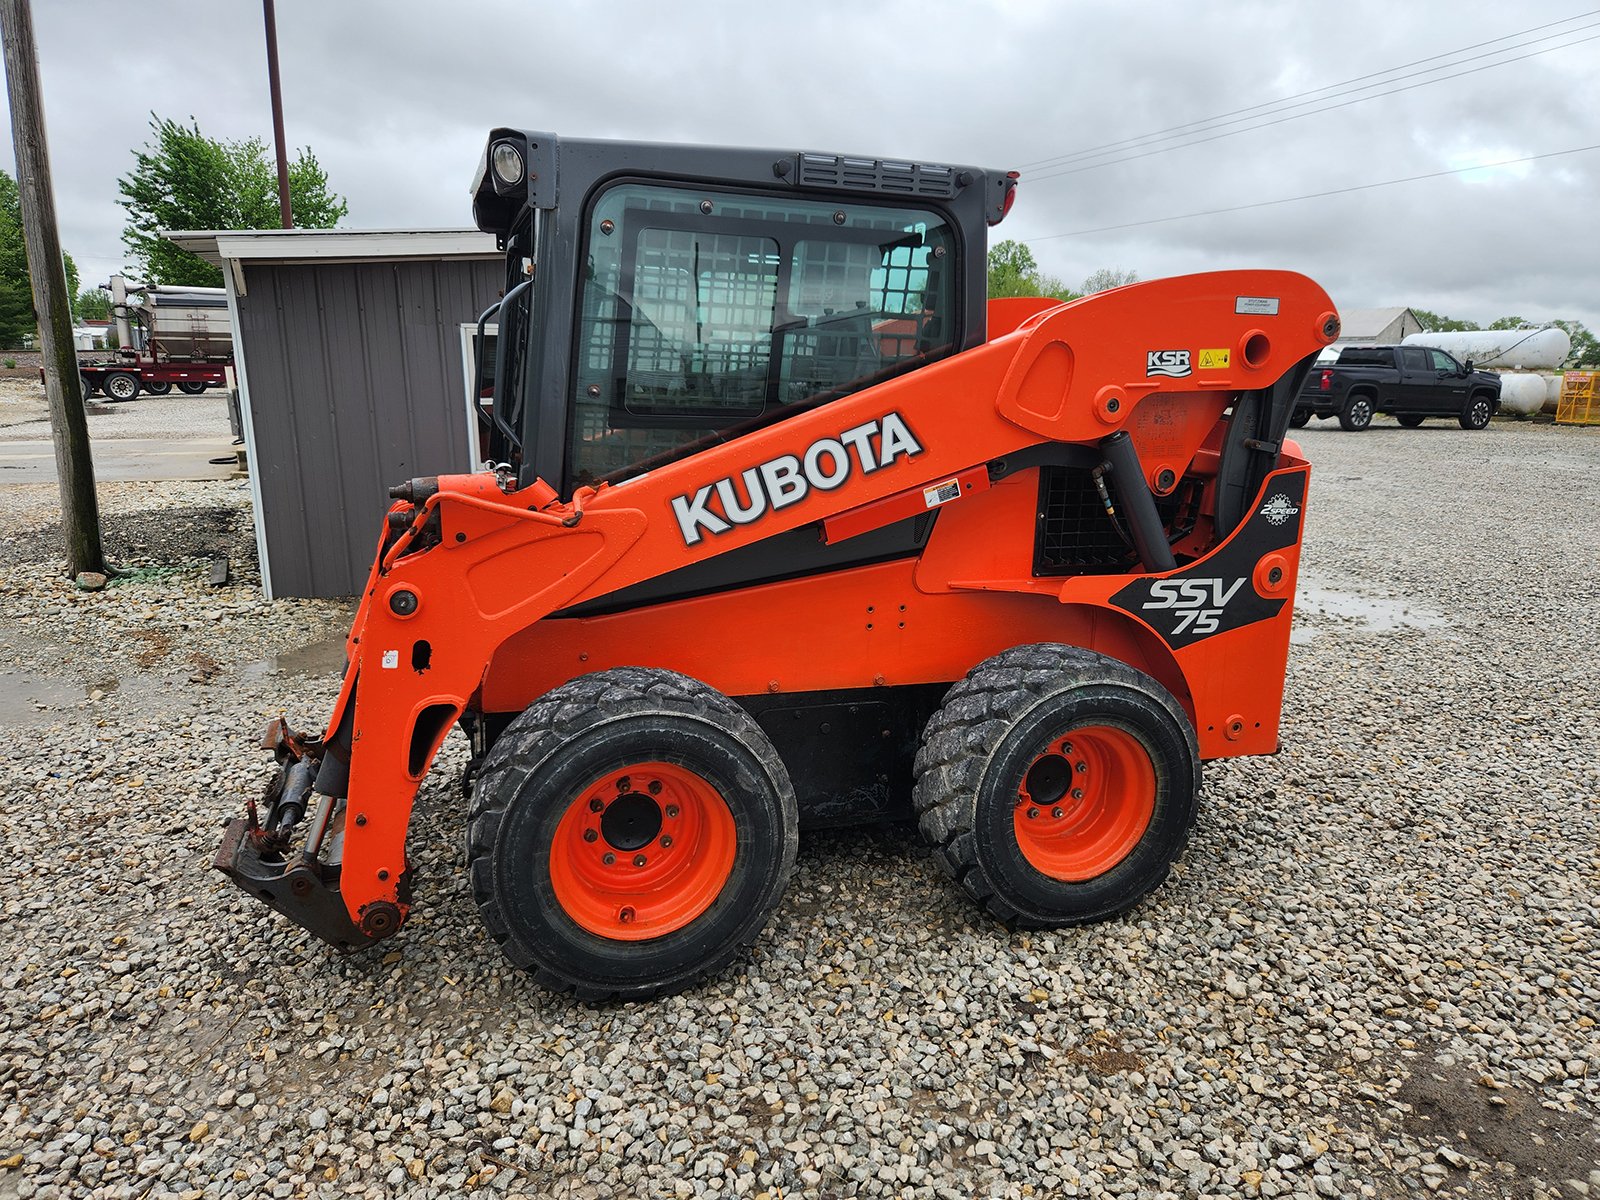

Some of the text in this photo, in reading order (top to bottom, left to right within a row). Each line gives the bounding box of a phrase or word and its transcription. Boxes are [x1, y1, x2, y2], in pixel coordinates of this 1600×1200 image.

[1147, 350, 1191, 366] KSR
[671, 411, 923, 546] KUBOTA
[1141, 577, 1248, 610] SSV
[1170, 608, 1224, 635] 75
